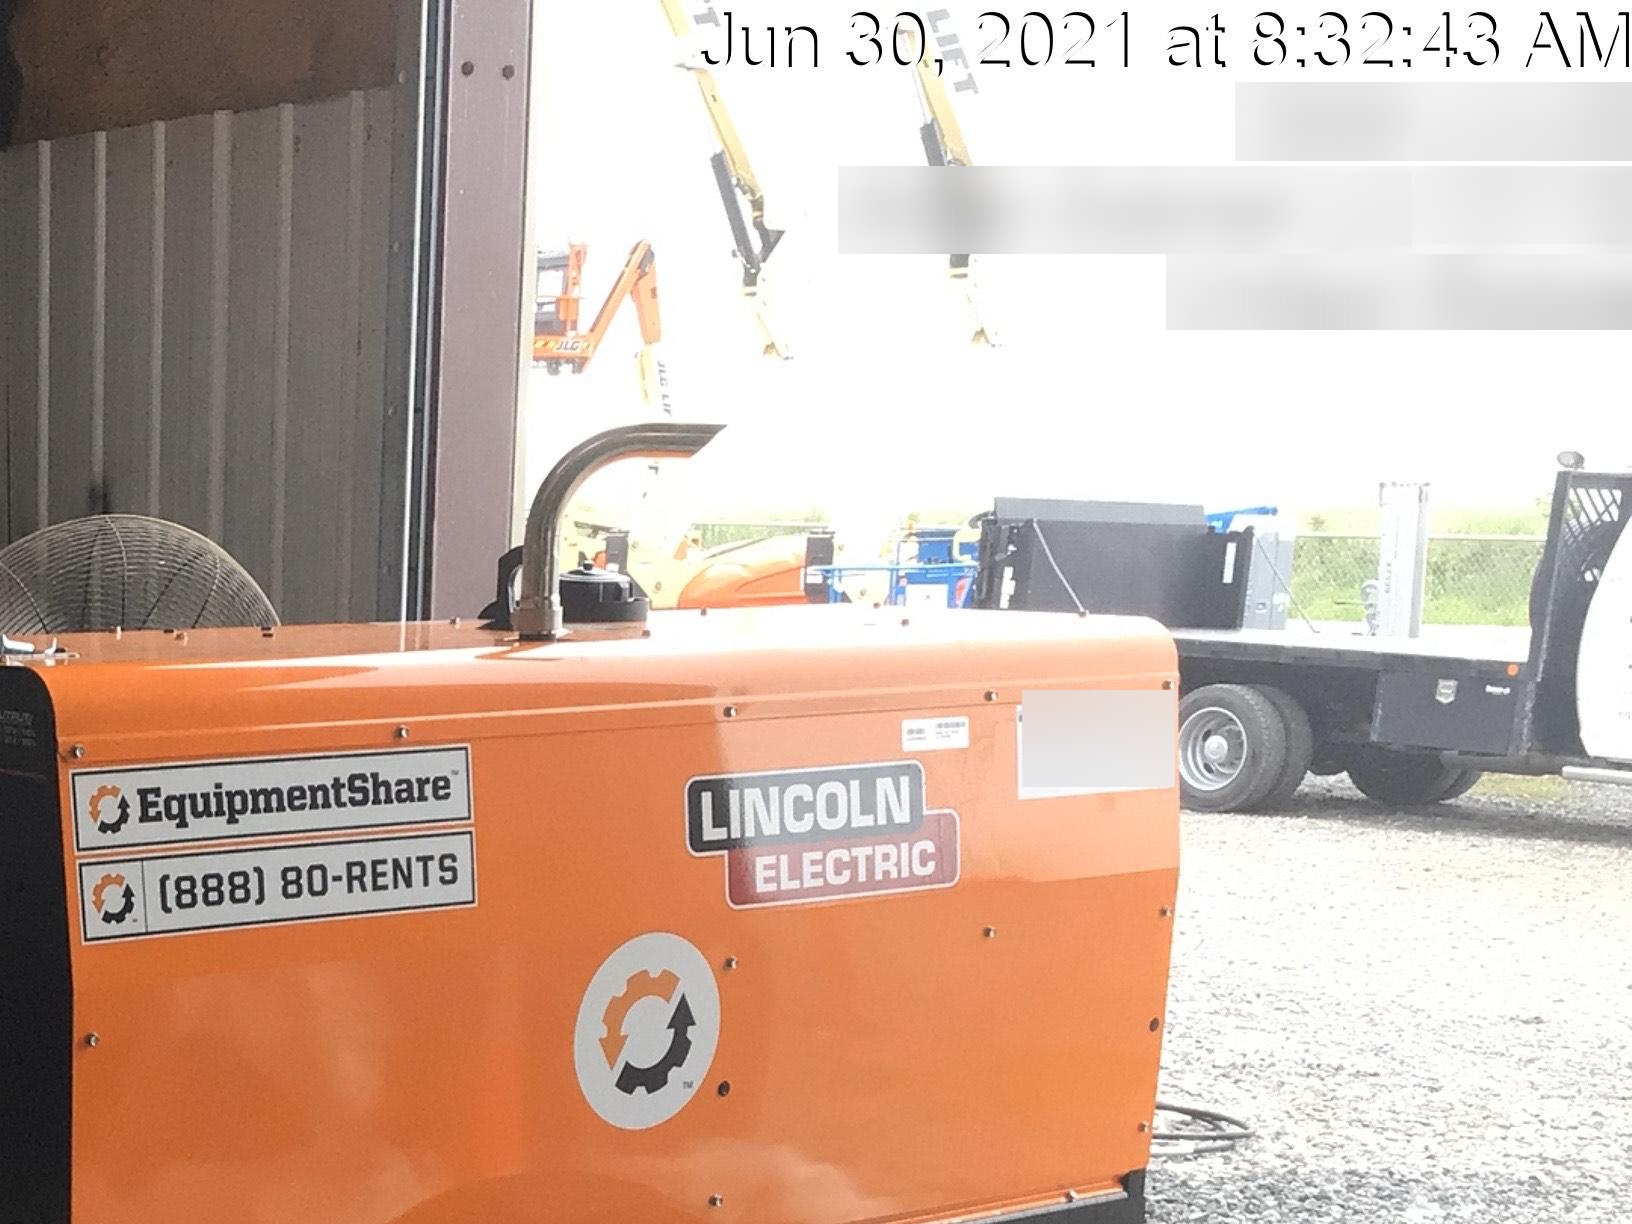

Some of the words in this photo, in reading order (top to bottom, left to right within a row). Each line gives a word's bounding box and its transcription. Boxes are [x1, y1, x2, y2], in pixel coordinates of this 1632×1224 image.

[926, 8, 980, 95] LIFT
[556, 340, 580, 351] JLG
[136, 772, 452, 829] EquipmentShare
[700, 775, 912, 842] LINCOLN
[159, 866, 265, 914] (888)
[280, 853, 458, 900] 80-RENTS
[754, 840, 937, 893] ELECTRIC
